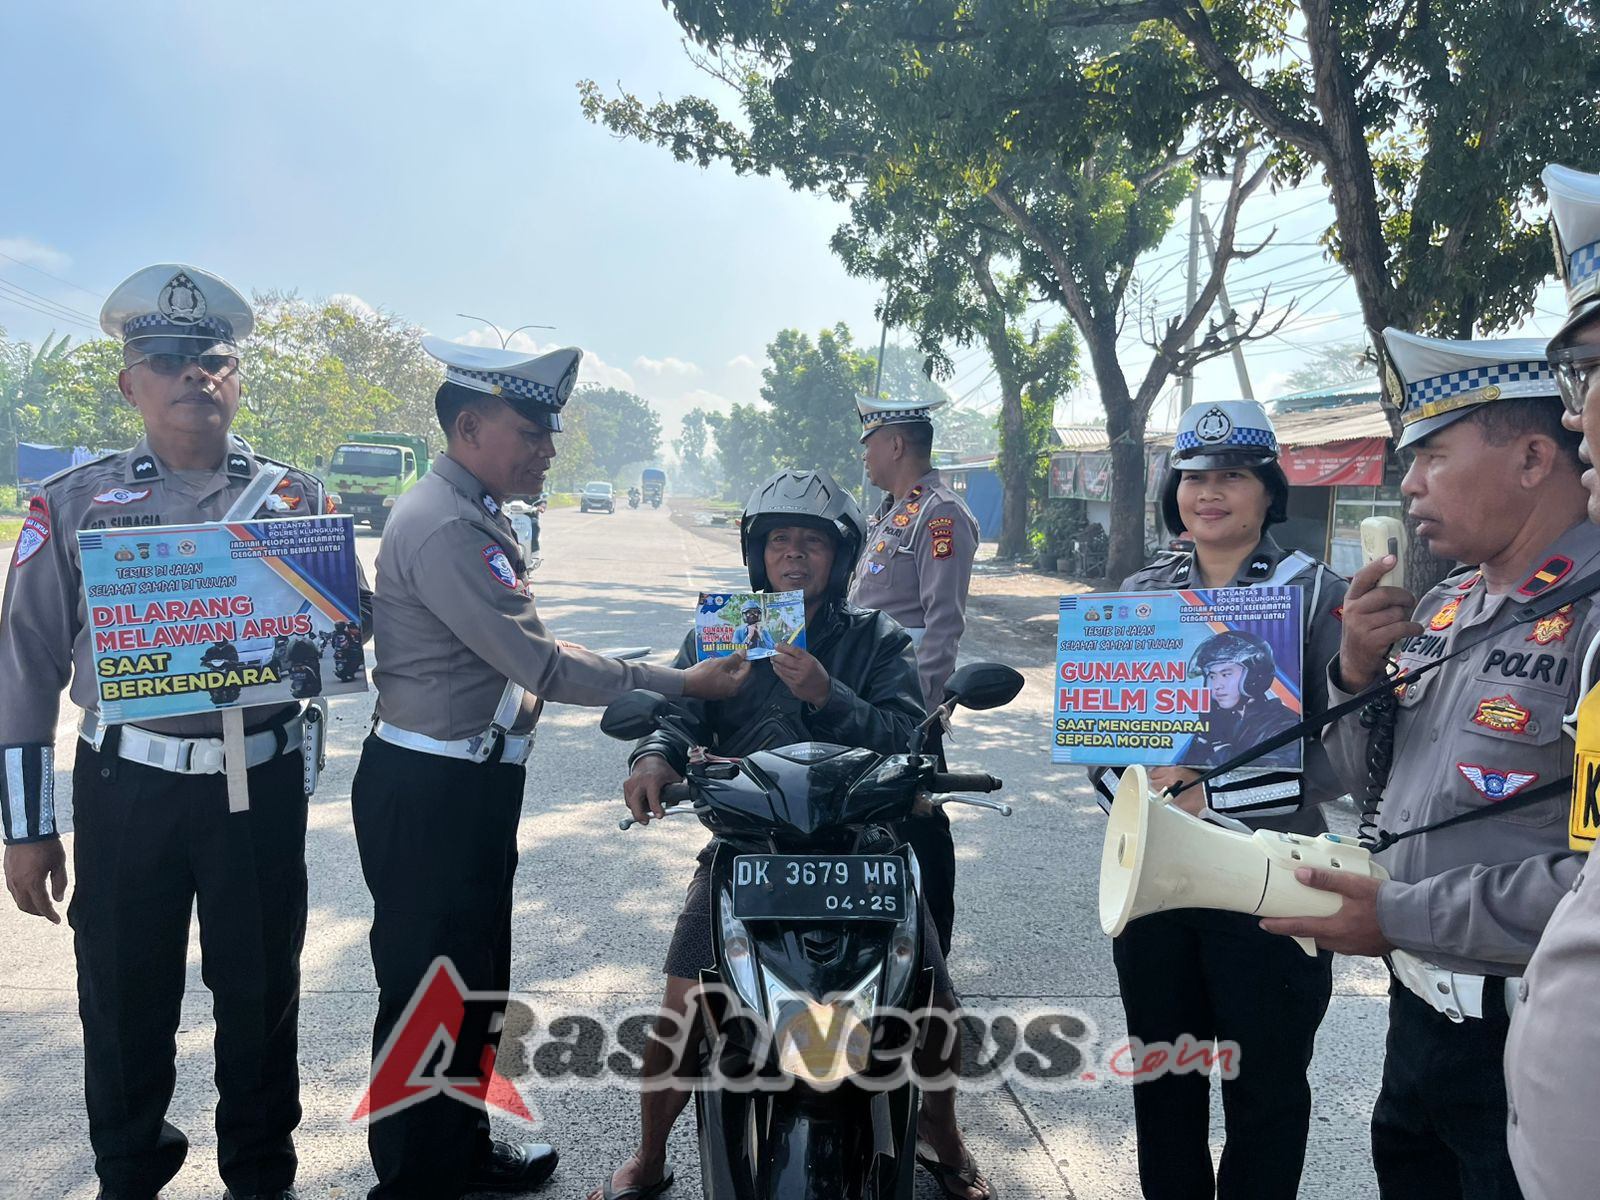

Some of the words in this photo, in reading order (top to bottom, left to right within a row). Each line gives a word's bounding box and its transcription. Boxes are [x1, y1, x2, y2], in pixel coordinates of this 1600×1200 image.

[268, 522, 311, 530] SATLANTAS
[300, 527, 345, 535] KLUNGKUNG
[262, 538, 295, 547] PELOPOR
[116, 565, 153, 579] TERTIB
[155, 565, 167, 577] DI
[169, 562, 203, 576] JALAN
[89, 582, 136, 597] SELAMAT
[139, 579, 180, 594] SAMPAI
[181, 579, 194, 590] DI
[195, 575, 237, 588] TUJUAN
[92, 595, 252, 628] DILARANG
[95, 620, 236, 653] MELAWAN
[241, 614, 312, 640] ARUS
[1083, 625, 1113, 637] TERTIB
[1115, 625, 1125, 636] DI
[1126, 625, 1155, 636] JALAN
[1060, 640, 1098, 651] SELAMAT
[1100, 640, 1133, 651] SAMPAI
[1135, 640, 1145, 650] DI
[1147, 639, 1184, 650] TUJUAN
[99, 653, 169, 677] SAAT
[1060, 661, 1186, 682] GUNAKAN
[1482, 648, 1568, 686] POLRI
[101, 666, 279, 701] BERKENDARA
[1059, 687, 1147, 713] HELM
[1154, 687, 1211, 713] SNI
[1056, 718, 1096, 732] SAAT
[1098, 719, 1210, 733] MENGENDARAI
[1056, 733, 1113, 746] SEPEDA
[1117, 735, 1172, 747] MOTOR
[737, 861, 770, 886] DK
[786, 861, 849, 885] 3679
[863, 861, 897, 885] MR
